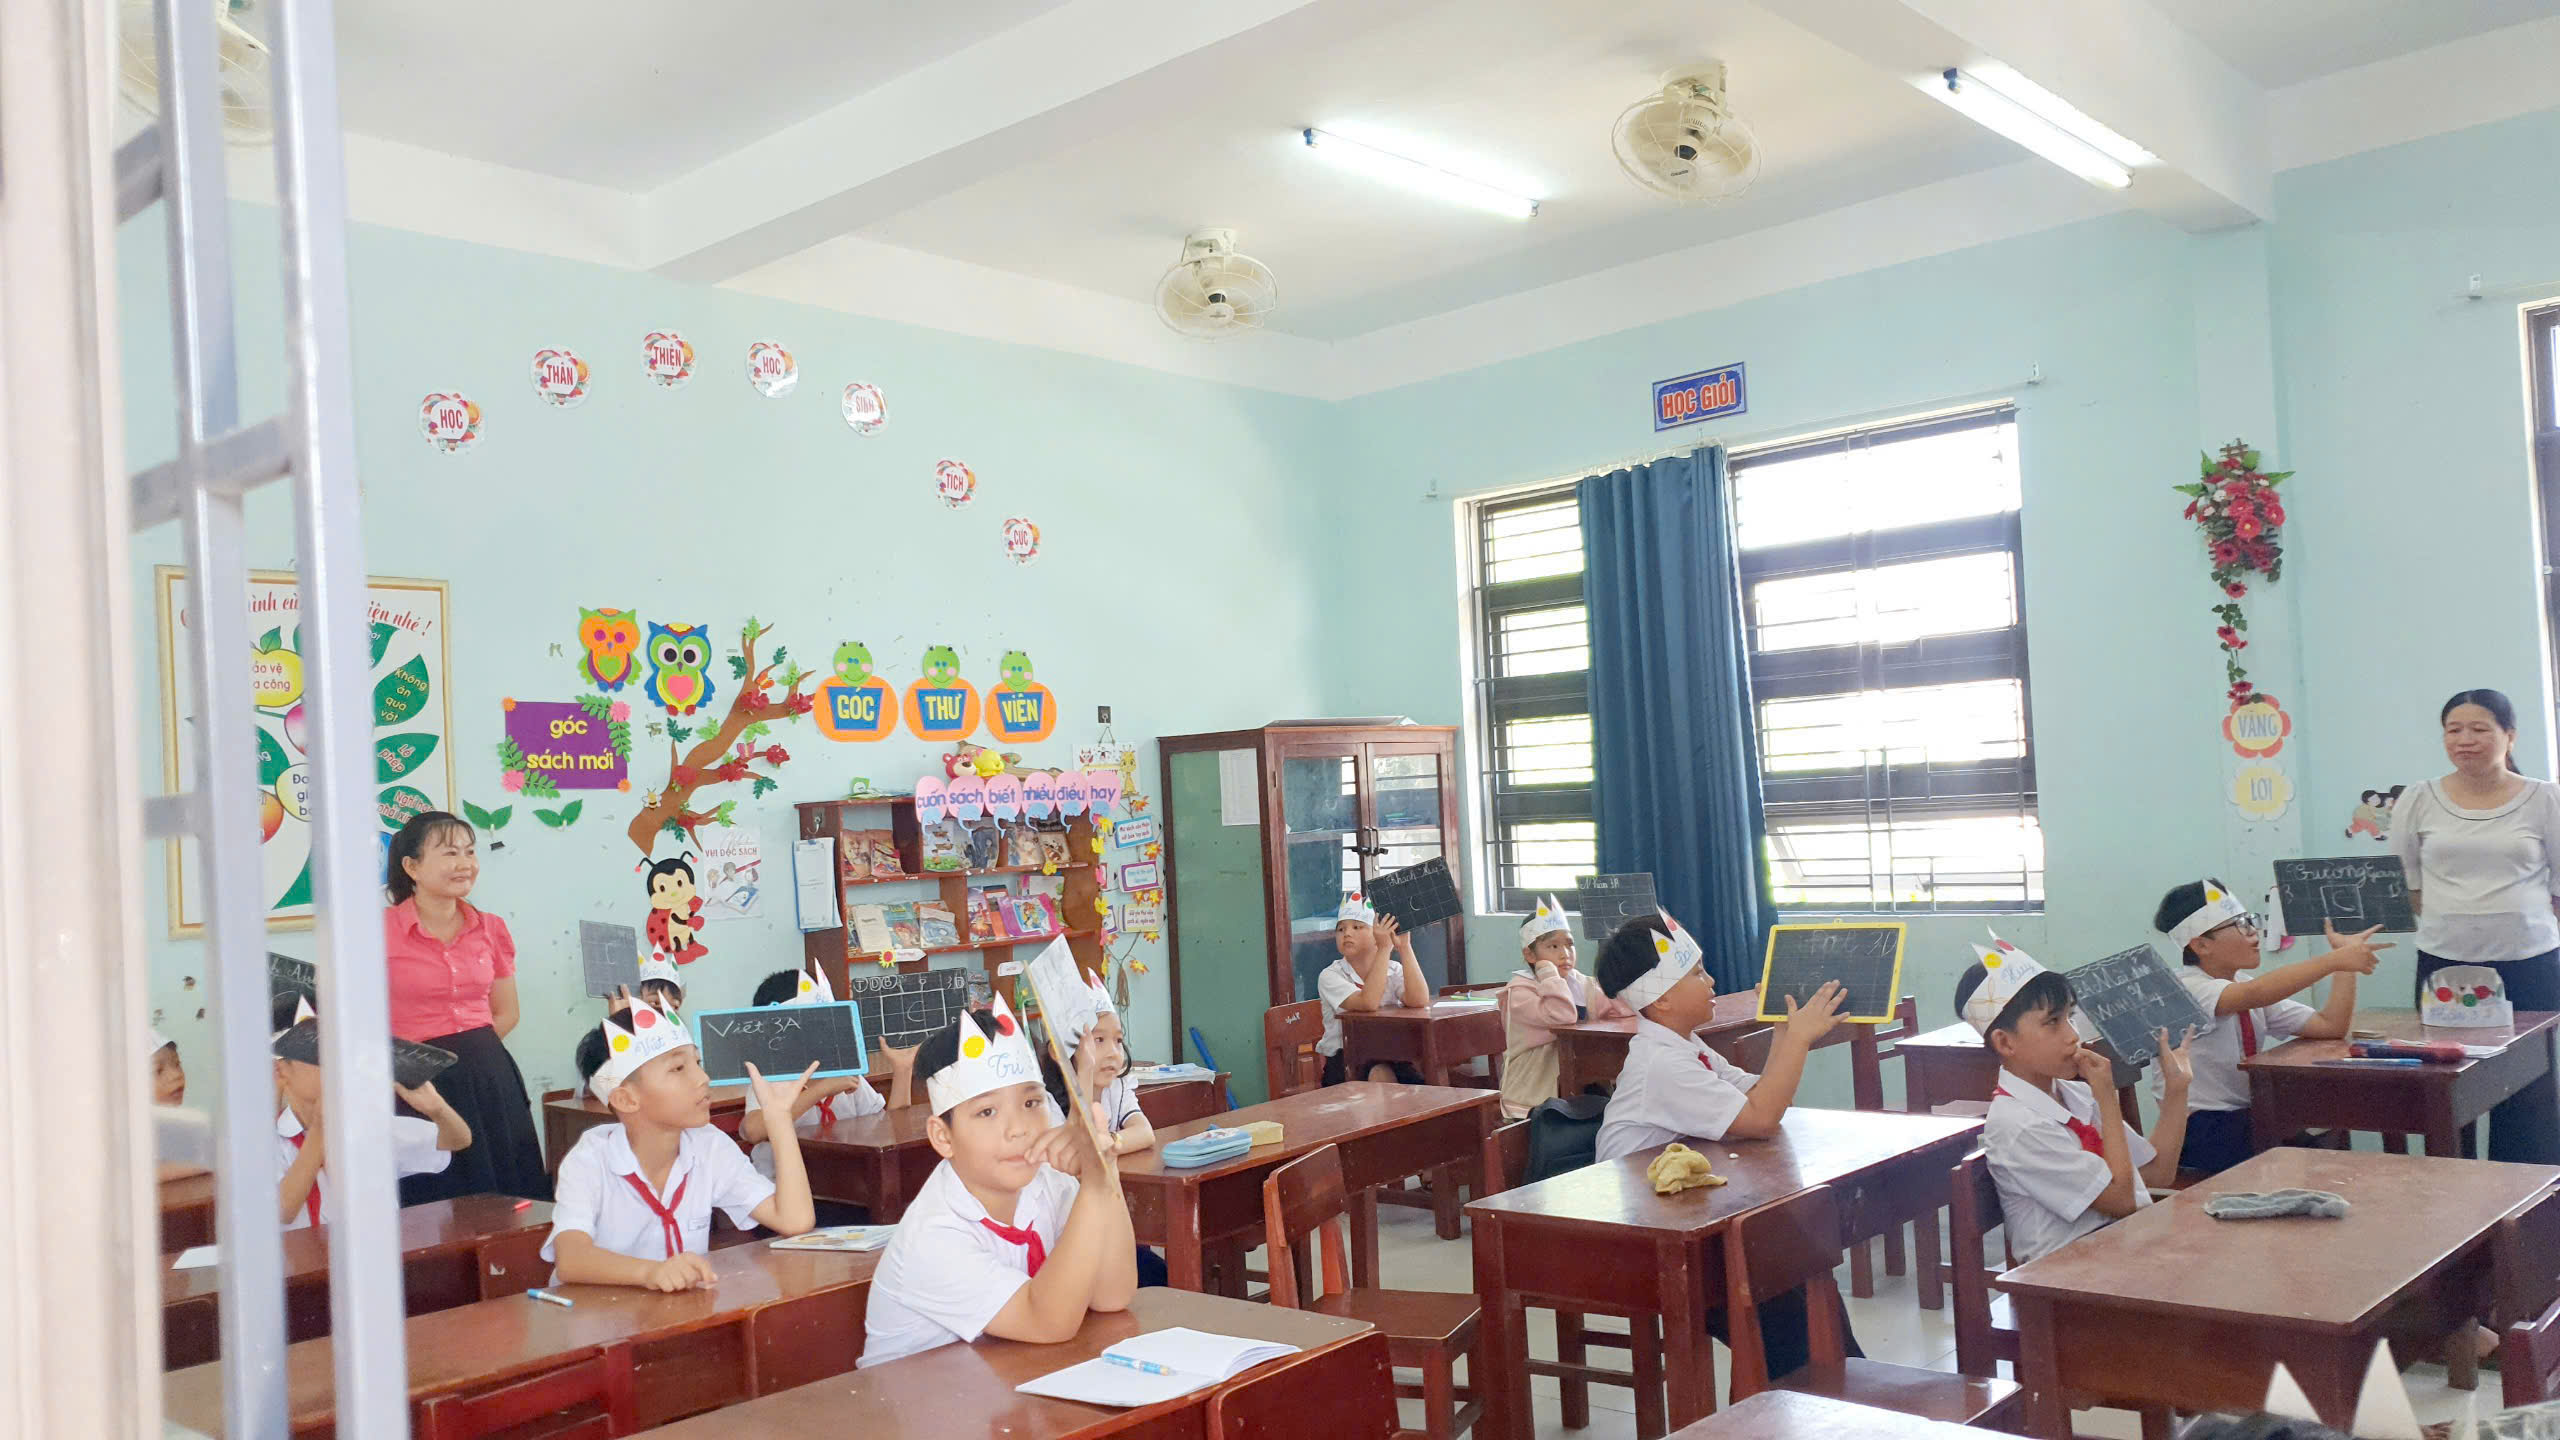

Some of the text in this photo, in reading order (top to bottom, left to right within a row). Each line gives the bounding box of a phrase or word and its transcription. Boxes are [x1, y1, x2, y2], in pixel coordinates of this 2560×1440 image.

[440, 408, 463, 433] HỌC
[546, 361, 573, 386] THÂN
[654, 344, 681, 370] THIỆN
[1662, 373, 1736, 422] HỌC GIỎI
[250, 591, 279, 613] ình
[366, 600, 390, 625] iện
[252, 662, 283, 675] ảo vệ
[263, 678, 291, 691] công
[837, 687, 1039, 726] GÓC THƯ VIỆN
[550, 714, 588, 739] góc
[527, 747, 614, 769] sách mới
[917, 782, 1117, 808] cuốn sách biết nhiều điều hay
[705, 849, 718, 857] VUI
[720, 848, 737, 858] ĐỌC
[770, 1017, 801, 1034] 3A
[768, 1036, 783, 1051] C
